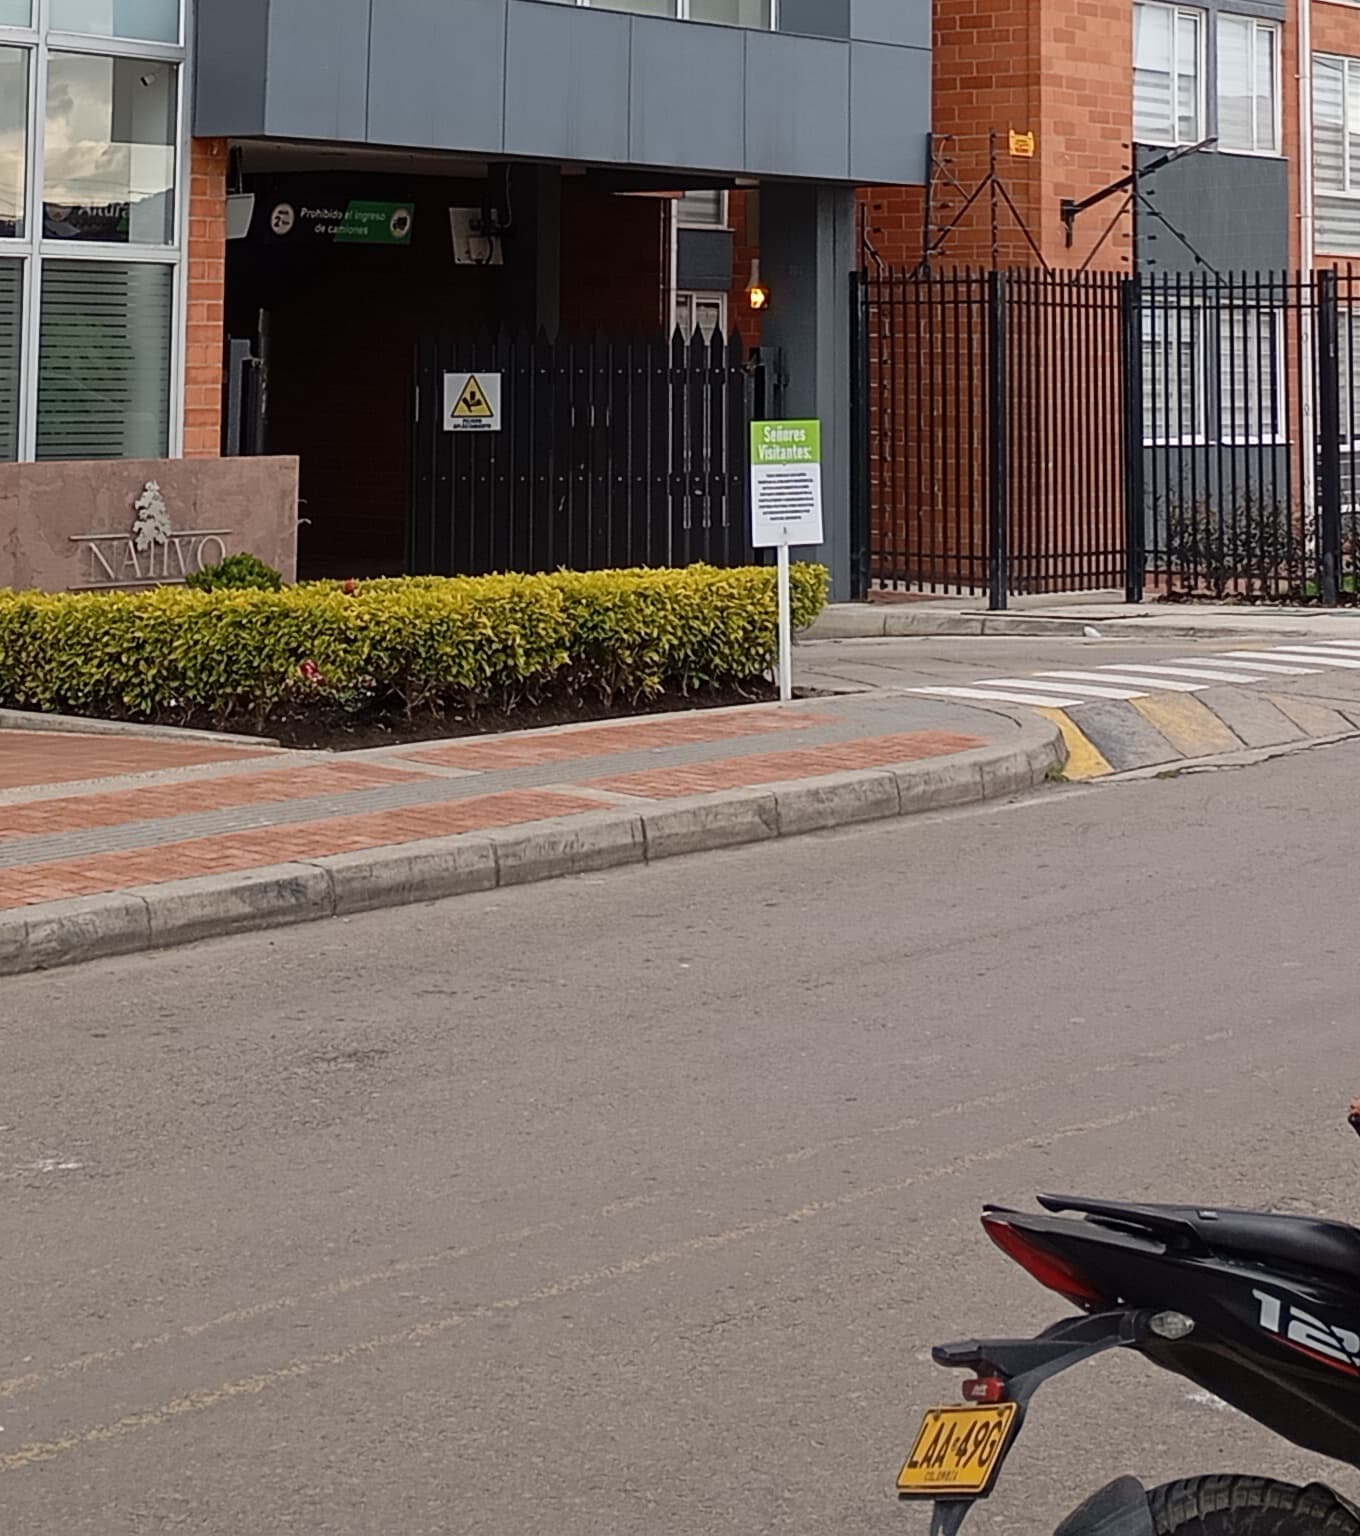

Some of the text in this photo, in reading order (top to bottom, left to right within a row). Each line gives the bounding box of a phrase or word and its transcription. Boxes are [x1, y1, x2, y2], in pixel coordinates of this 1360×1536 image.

[300, 207, 344, 221] Prohibido
[344, 209, 353, 220] el
[354, 210, 386, 223] ingreso
[314, 224, 369, 235] de camiones
[763, 425, 806, 443] Señores
[758, 444, 812, 461] Visitantes:
